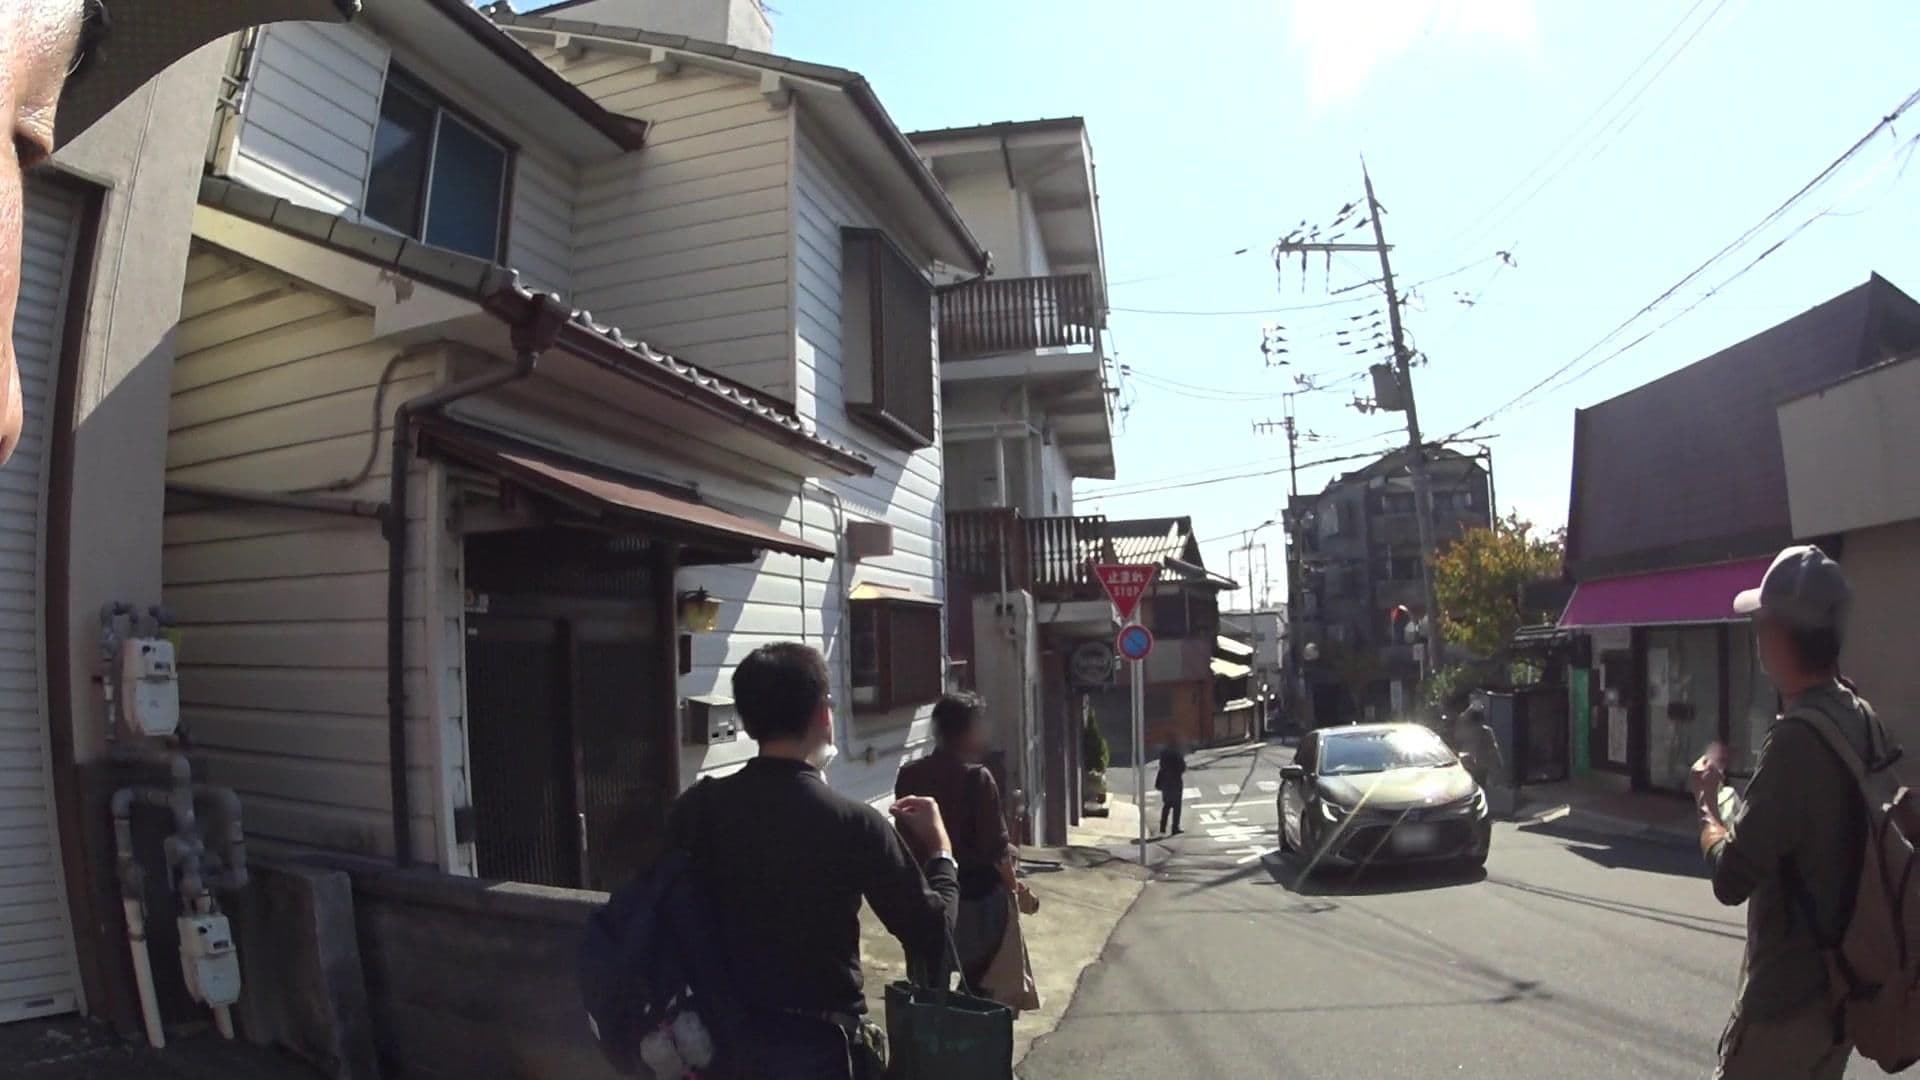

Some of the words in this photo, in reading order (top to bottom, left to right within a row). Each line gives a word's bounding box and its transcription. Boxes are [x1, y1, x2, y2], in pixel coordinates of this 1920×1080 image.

[1107, 570, 1144, 584] 止まれ
[1114, 585, 1140, 597] STOP
